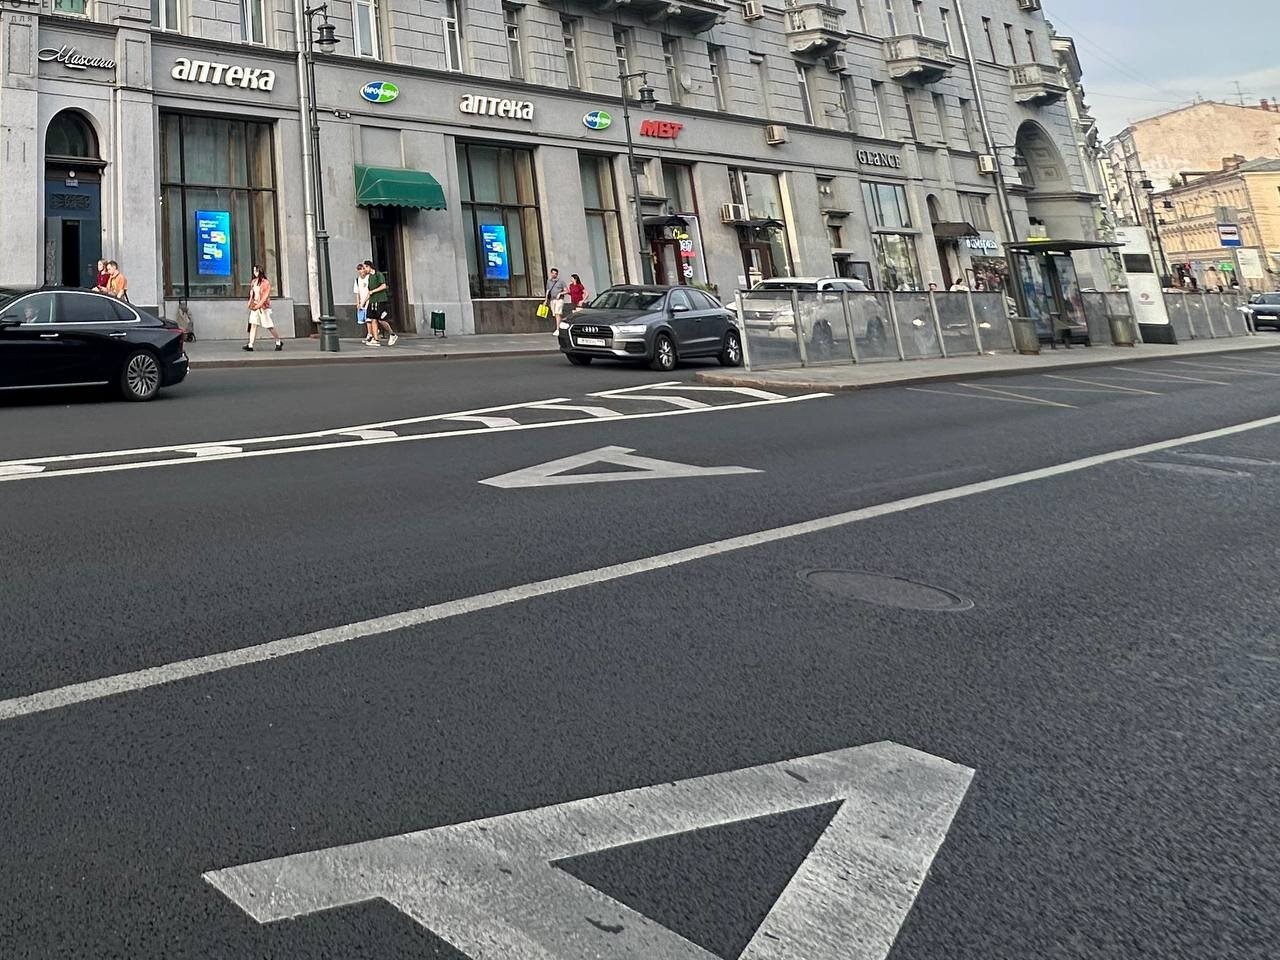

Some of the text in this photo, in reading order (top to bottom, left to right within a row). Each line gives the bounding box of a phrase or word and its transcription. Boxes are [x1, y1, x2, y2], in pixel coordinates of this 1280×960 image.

[38, 44, 116, 69] Mascara
[171, 57, 276, 92] аптека
[460, 93, 535, 121] аптека
